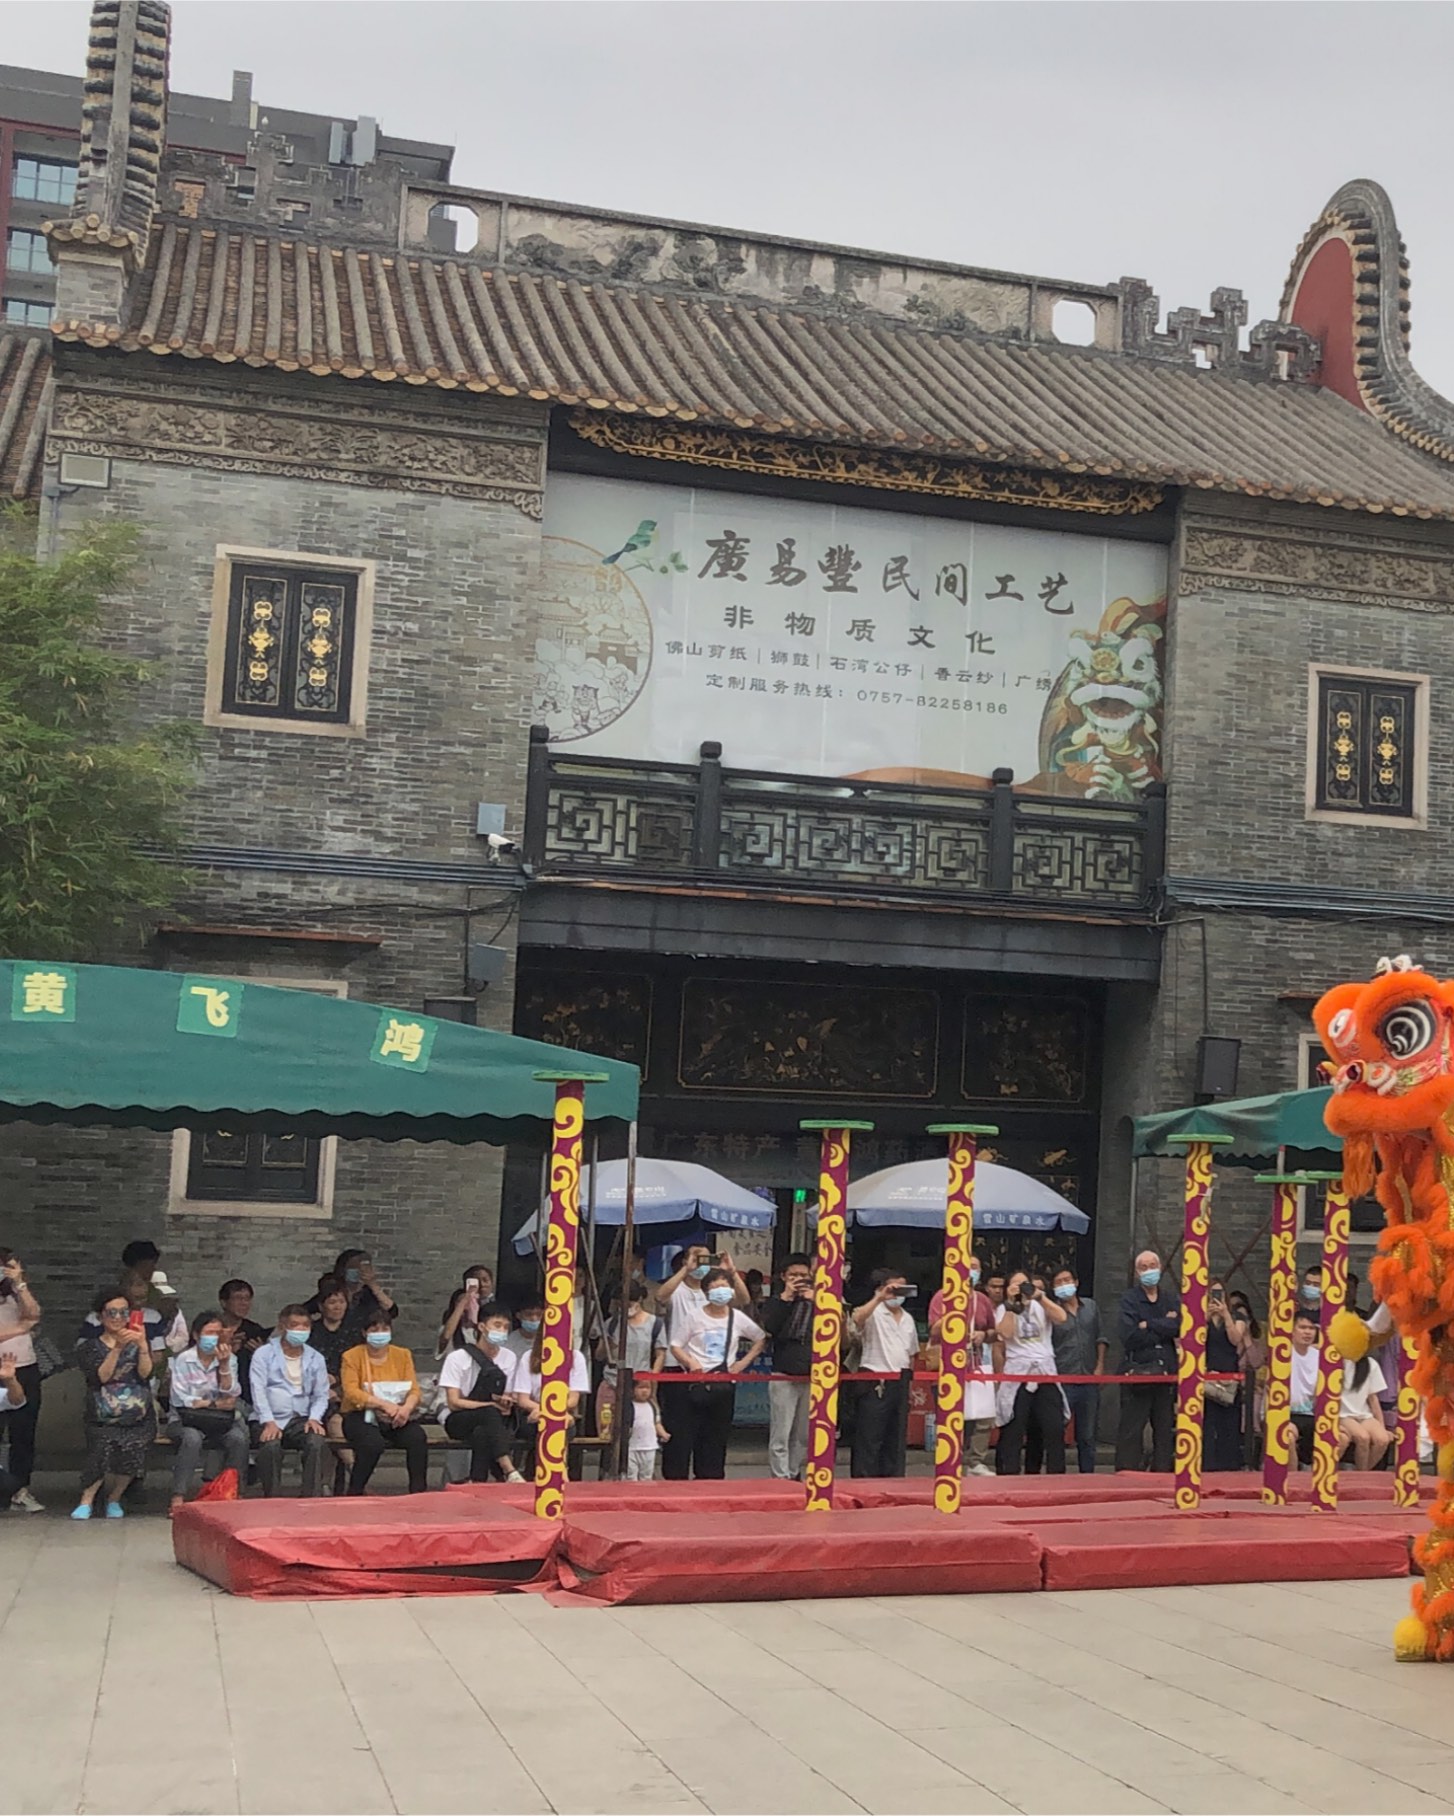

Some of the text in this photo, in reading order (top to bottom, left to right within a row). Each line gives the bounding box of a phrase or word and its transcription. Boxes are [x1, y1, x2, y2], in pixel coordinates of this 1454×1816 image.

[723, 604, 996, 655] 非物质文化
[665, 640, 747, 661] 佛山剪纸
[770, 650, 811, 668] 狮鼓
[829, 656, 913, 677] 石湾公仔
[934, 667, 994, 684] 香云纱
[856, 689, 1008, 715] 0757-82258186
[22, 972, 425, 1063] 黄飞鸿
